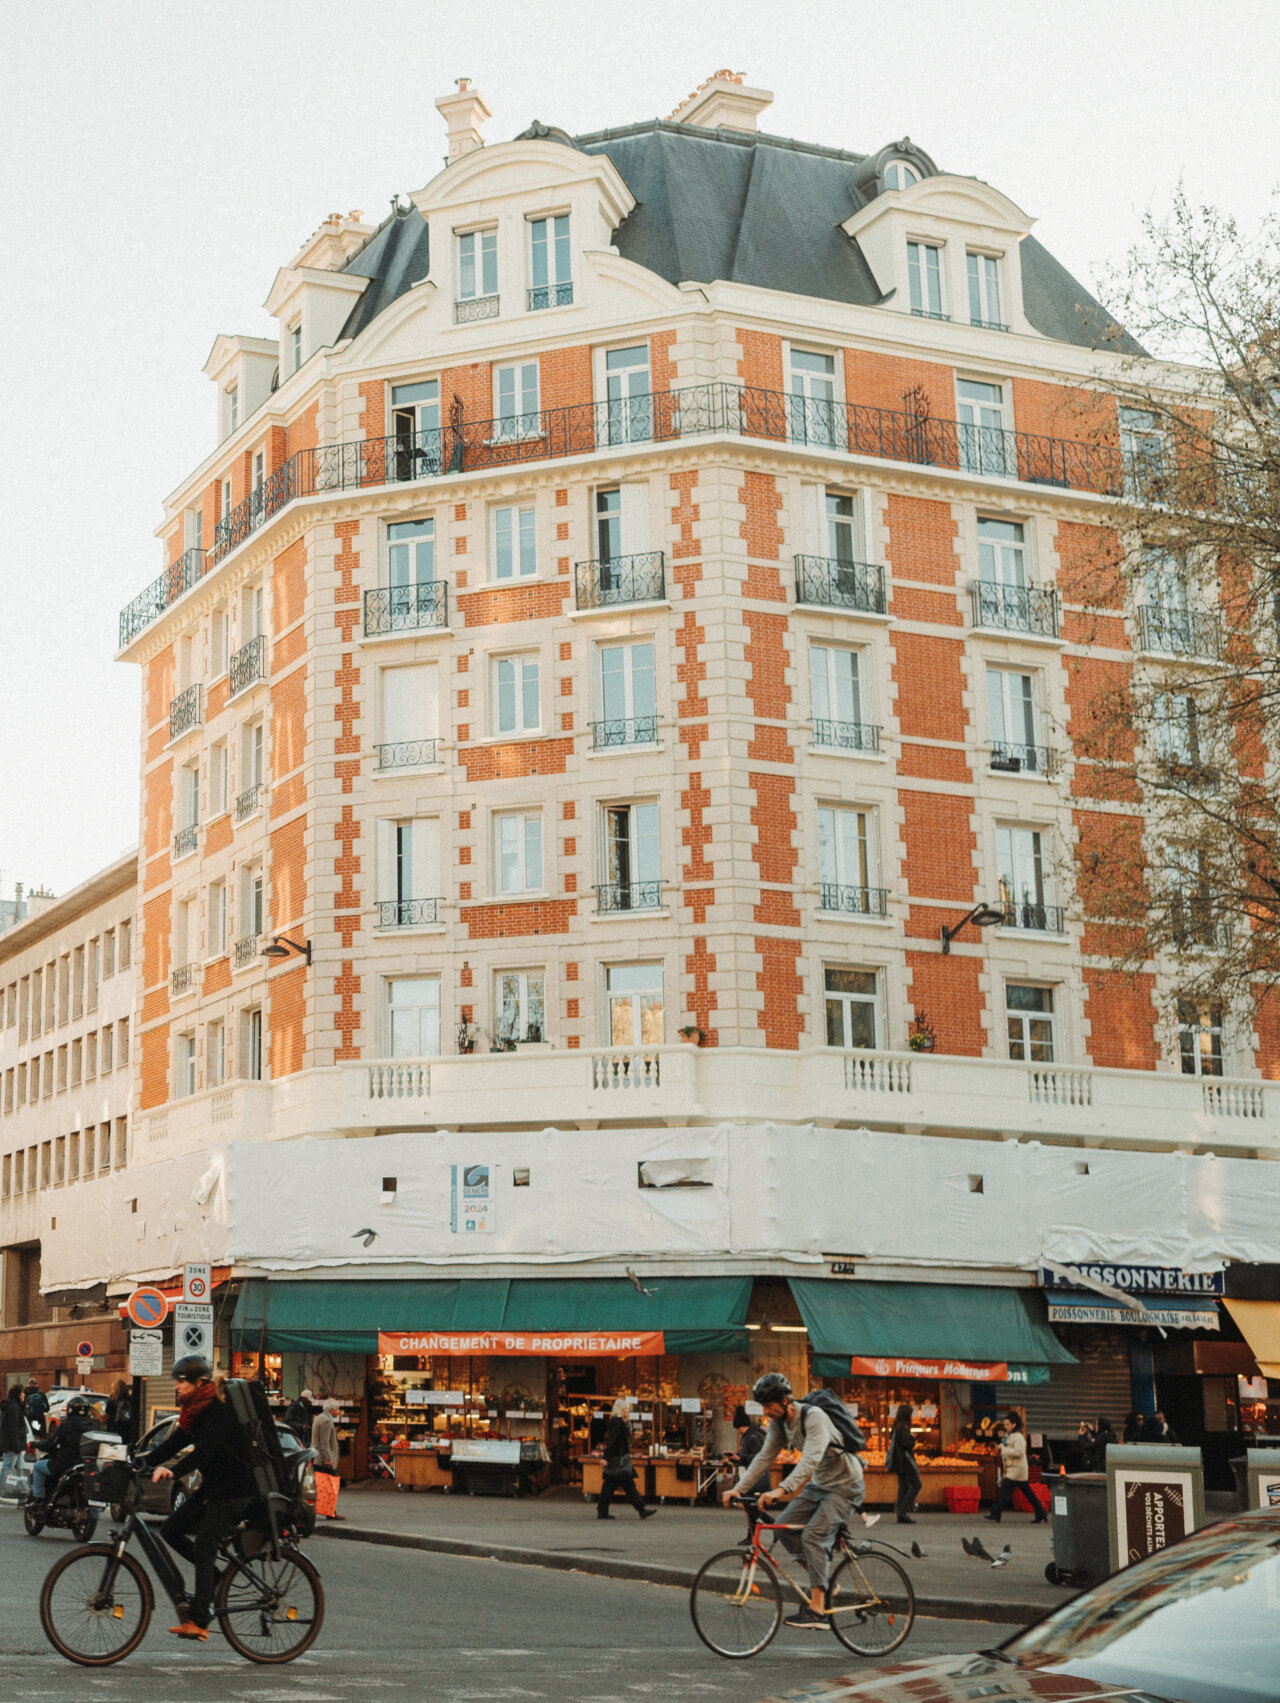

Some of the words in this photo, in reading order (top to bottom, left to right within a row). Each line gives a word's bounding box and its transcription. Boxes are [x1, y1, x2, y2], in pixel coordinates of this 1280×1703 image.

[464, 1204, 488, 1213] 2024
[192, 1283, 203, 1292] 30
[177, 1312, 211, 1320] TOURISTIQUE
[1052, 1308, 1116, 1321] POISSONNERIE
[400, 1337, 498, 1350] CHANGEMENT
[505, 1337, 525, 1350] DE
[532, 1337, 642, 1351] PROPRIETAIRE
[895, 1360, 939, 1376] Primeurs
[943, 1362, 991, 1380] Modernes
